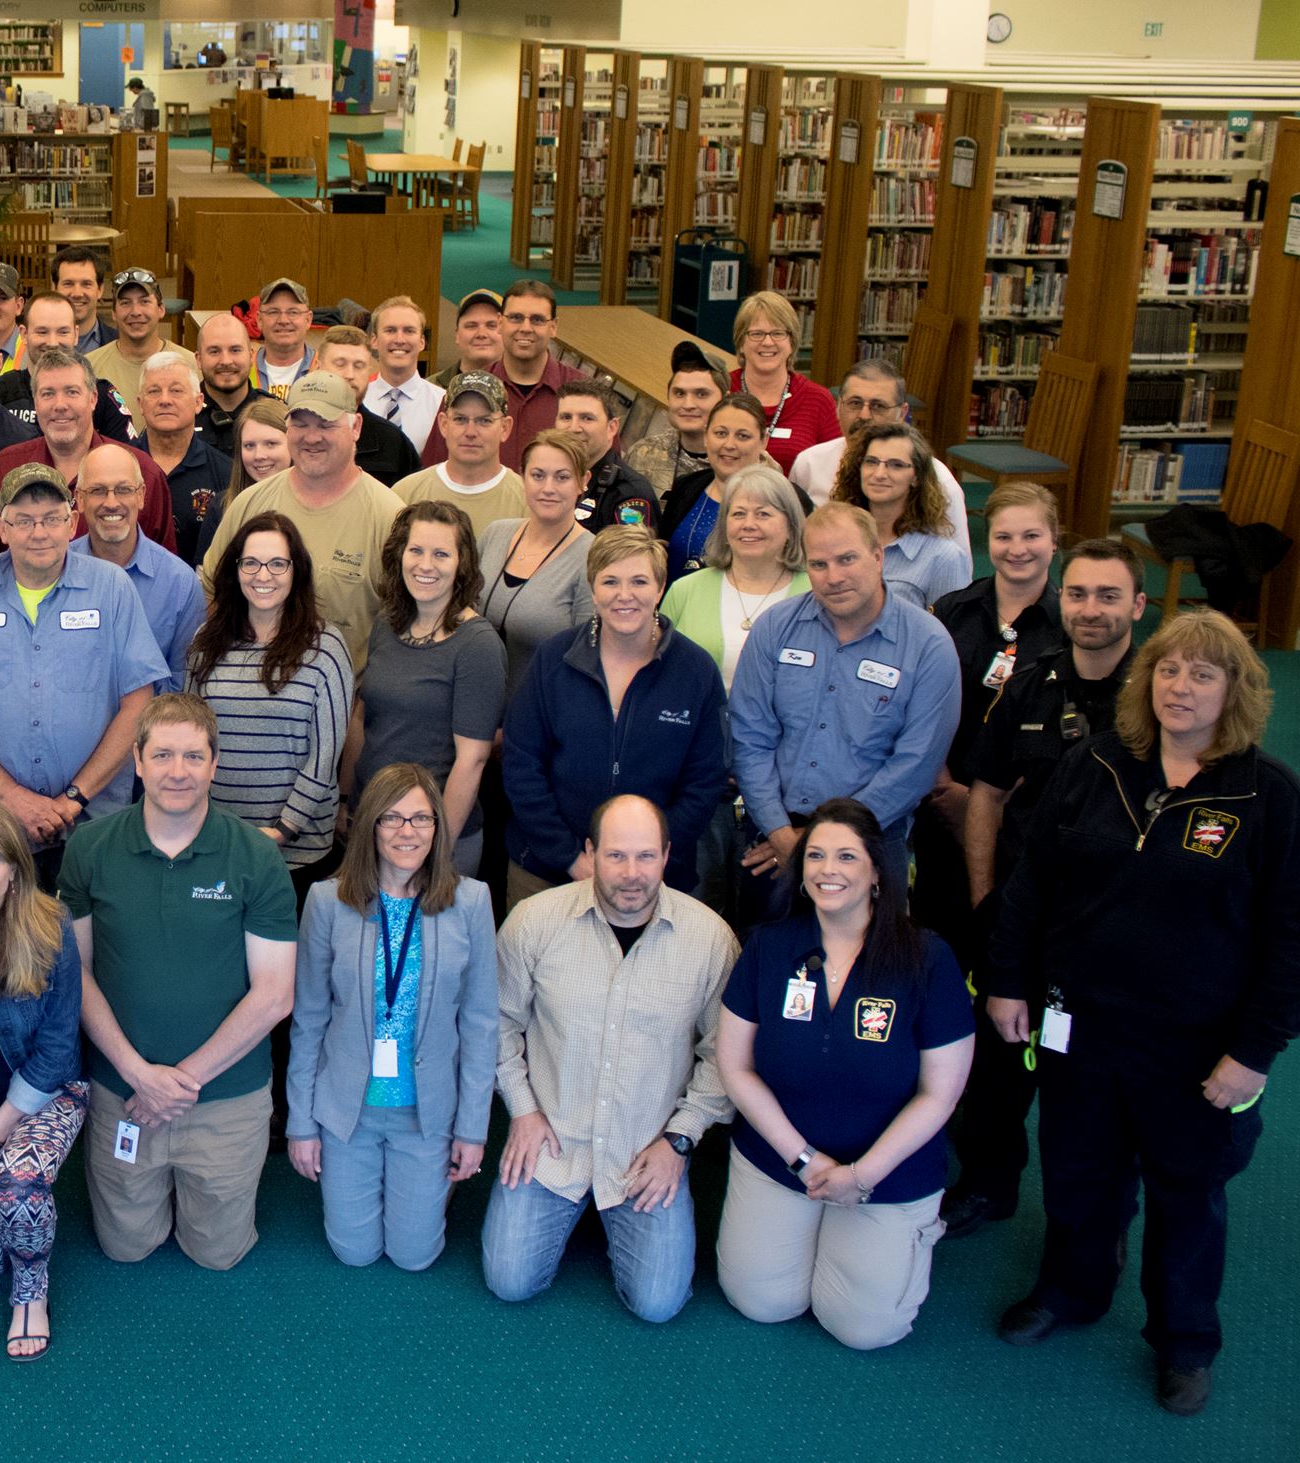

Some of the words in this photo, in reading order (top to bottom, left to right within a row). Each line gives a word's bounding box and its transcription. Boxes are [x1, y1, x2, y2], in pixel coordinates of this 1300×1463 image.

[79, 2, 145, 12] COMPUTERS
[1144, 22, 1164, 37] EXIT
[1232, 117, 1248, 126] 900
[1198, 809, 1216, 819] River
[1216, 814, 1233, 825] Falls
[1191, 842, 1214, 853] EMS
[214, 892, 232, 900] FALLS
[862, 1030, 882, 1039] EMS
